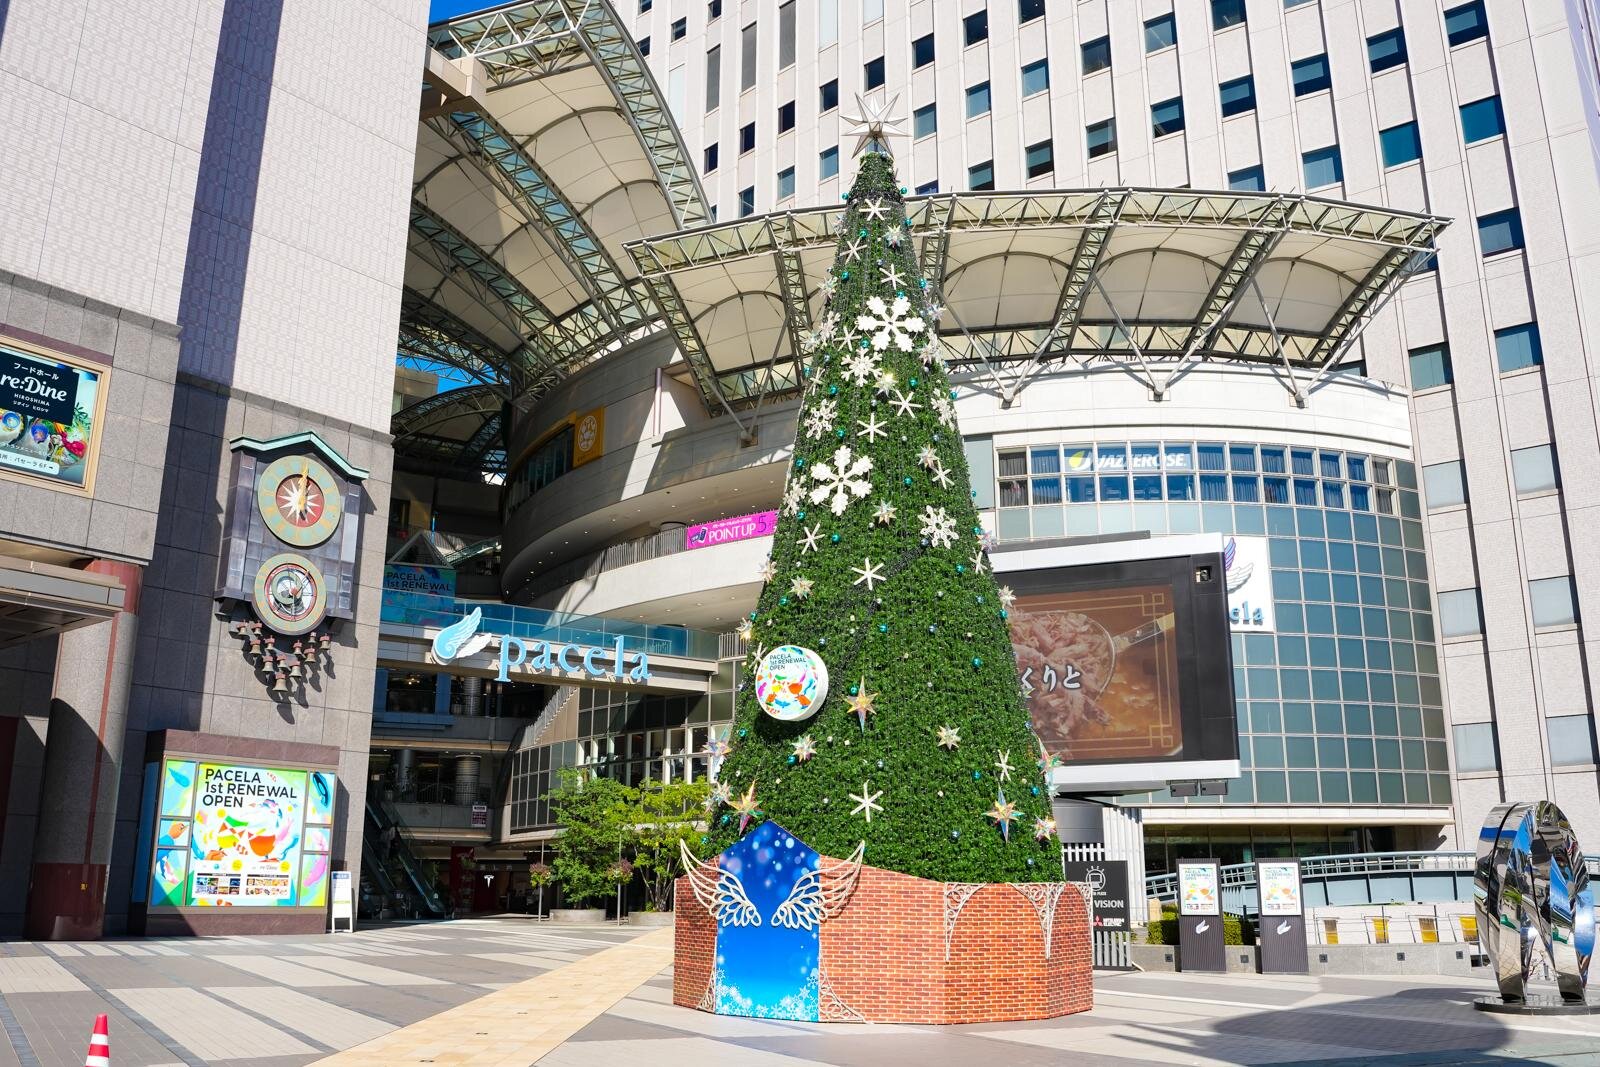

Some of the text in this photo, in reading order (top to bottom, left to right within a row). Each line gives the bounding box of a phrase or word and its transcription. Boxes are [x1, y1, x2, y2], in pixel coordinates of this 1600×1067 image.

[14, 362, 60, 381] フードホール
[0, 373, 67, 402] re:Dine
[14, 392, 50, 407] HIROSHIMA
[708, 525, 741, 543] POINT
[741, 522, 757, 537] UP
[386, 572, 426, 582] PACELA
[386, 580, 400, 588] 1st
[401, 581, 452, 592] RENEWAL
[494, 633, 653, 683] pacela
[777, 657, 807, 665] RENEWAL
[205, 768, 262, 784] PACELA
[204, 781, 298, 799] 1st RENEWAL
[202, 794, 244, 808] OPEN
[1093, 899, 1125, 909] VISION
